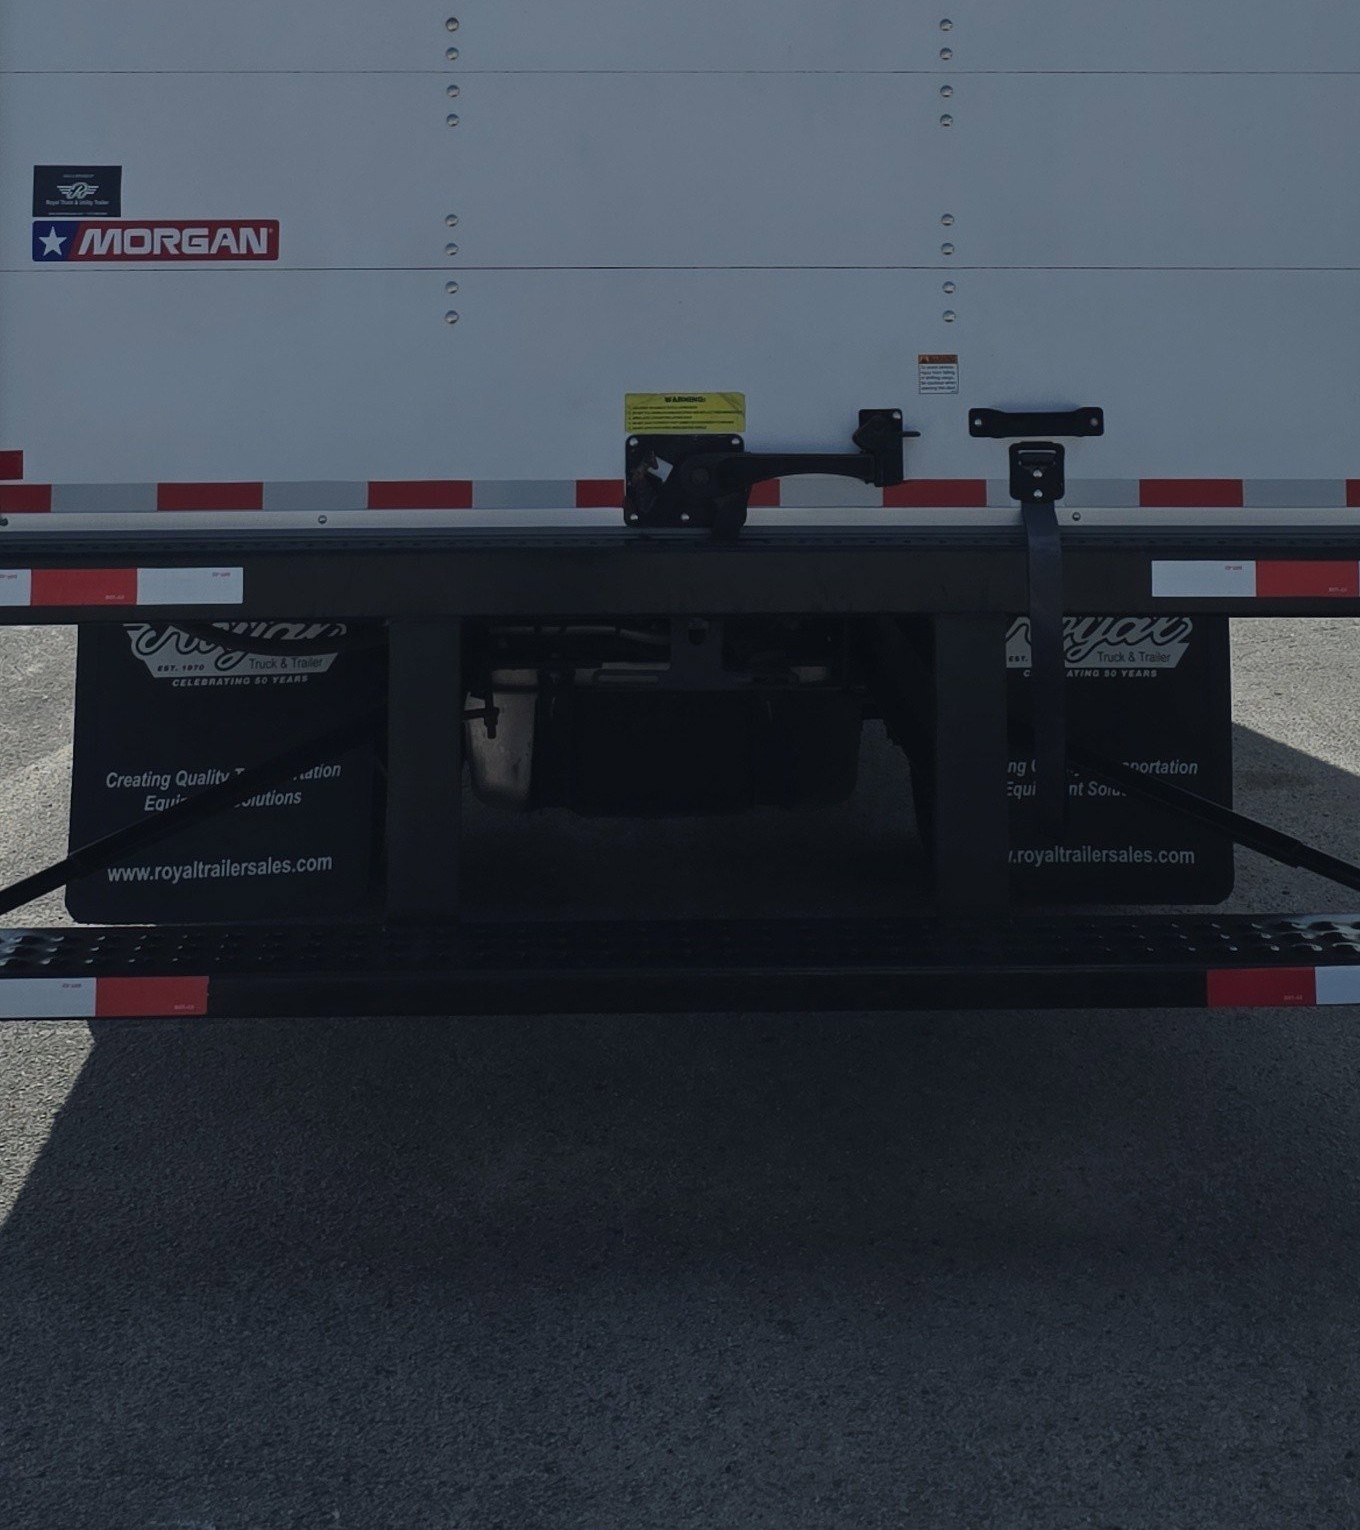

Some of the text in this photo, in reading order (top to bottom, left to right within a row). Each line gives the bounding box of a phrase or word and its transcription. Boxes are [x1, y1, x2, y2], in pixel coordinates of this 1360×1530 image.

[77, 226, 269, 256] MORGAN
[248, 656, 324, 670] Truck & Trailer
[1097, 650, 1171, 663] Truck & Trailer
[172, 674, 309, 687] CELEBRATING 50 YEARS
[1121, 669, 1158, 678] YEARS
[106, 771, 172, 790] Creating
[1008, 844, 1196, 868] .royaltrailersales.com
[107, 856, 333, 884] www.royaltrailersales.com
